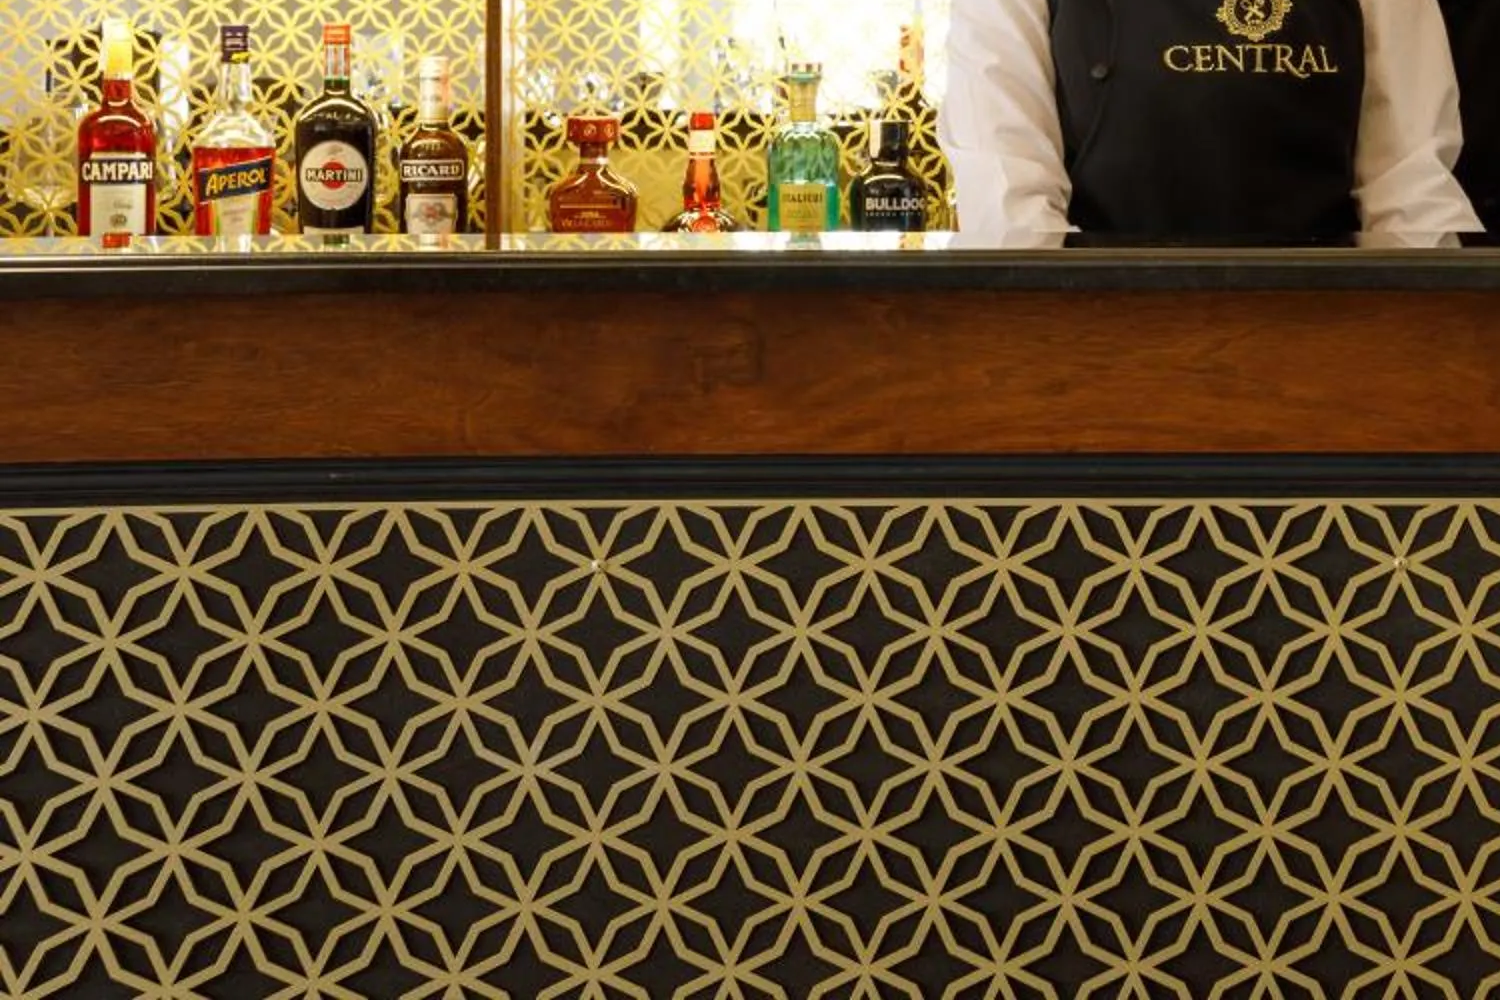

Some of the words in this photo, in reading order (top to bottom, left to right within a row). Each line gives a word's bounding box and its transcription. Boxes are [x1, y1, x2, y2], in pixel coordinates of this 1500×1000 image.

[1163, 44, 1339, 79] CENTRAL
[82, 161, 154, 181] CAMPARI
[305, 167, 364, 183] MARTINI
[403, 164, 461, 177] RICARD
[205, 168, 267, 197] APEROL
